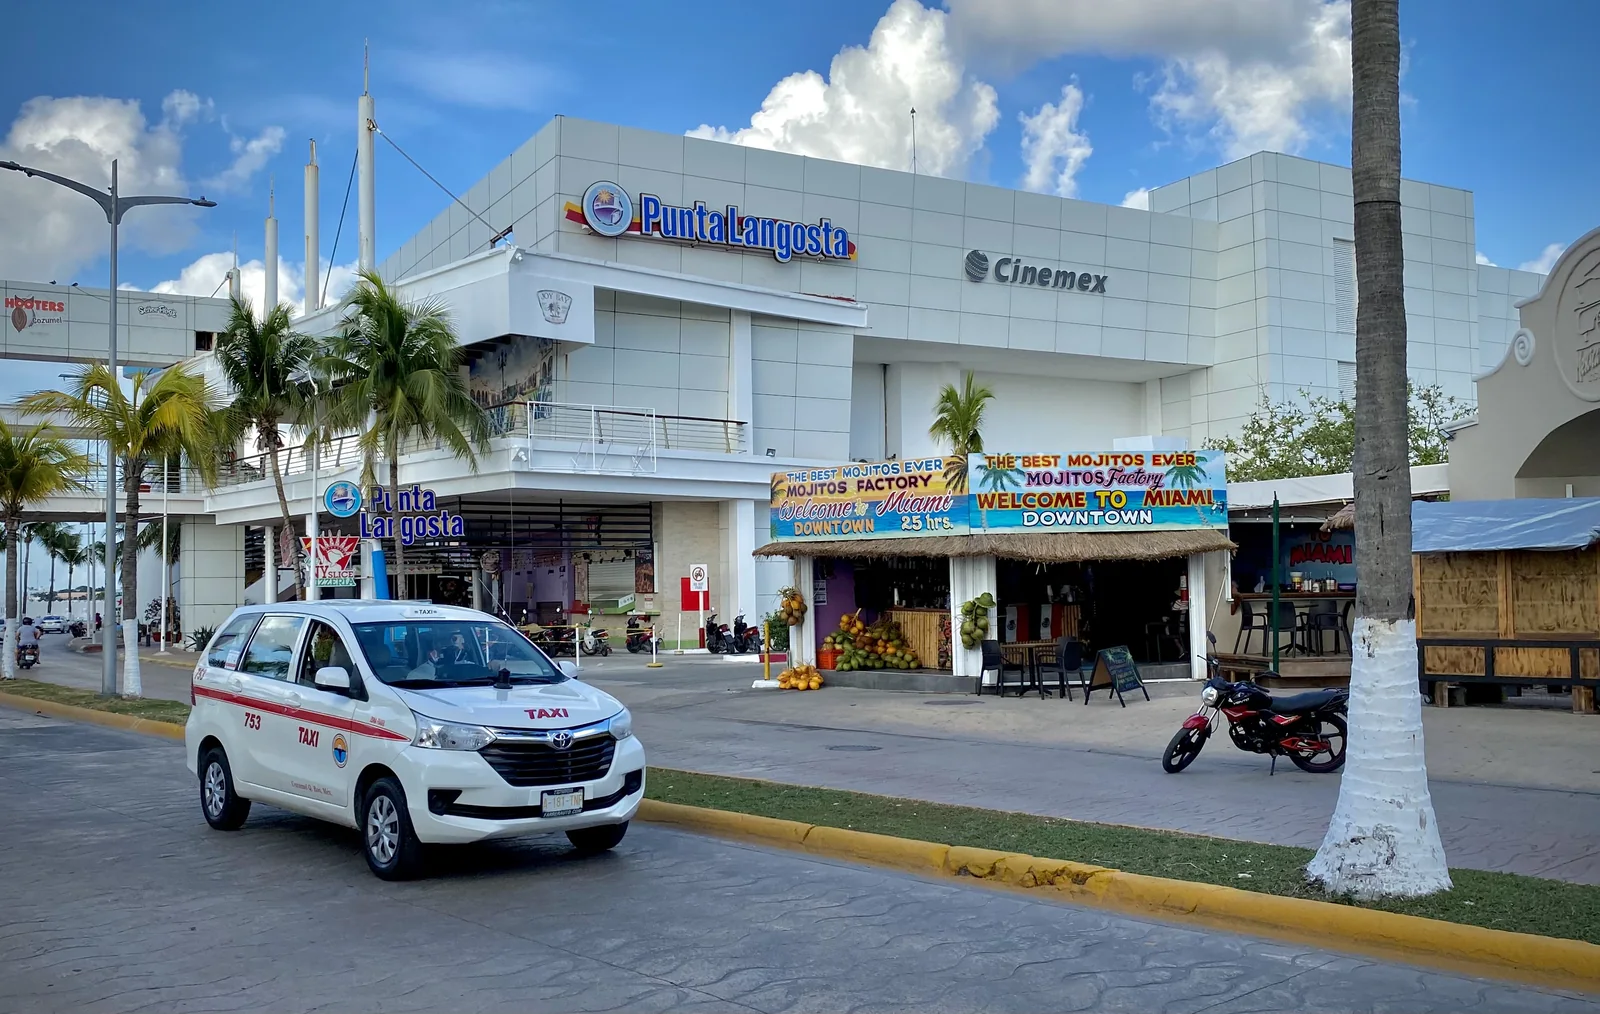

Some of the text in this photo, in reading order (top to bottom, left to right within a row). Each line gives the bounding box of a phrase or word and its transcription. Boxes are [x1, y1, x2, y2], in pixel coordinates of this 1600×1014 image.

[994, 257, 1108, 294] Cinemex
[5, 297, 65, 312] HOOTERS
[32, 316, 62, 324] Cozumel
[786, 458, 943, 483] THE BEST MOJITOS EVER
[985, 453, 1196, 469] THE BEST MOJITOS EVER
[786, 474, 933, 498] MOJITOS FACTORY
[1025, 466, 1165, 491] MOJITOS Factory
[369, 484, 437, 513] Punta
[779, 490, 954, 520] Welcome to Miami
[976, 489, 1214, 510] WELCOME TO MIAMI
[794, 518, 875, 536] DOWNTOWN
[901, 514, 954, 531] 25 hrs.
[1022, 510, 1153, 526] DOWNTOWN
[1290, 543, 1353, 567] MIAMI
[315, 578, 355, 587] IZZERIA
[244, 712, 261, 731] 753
[523, 708, 569, 720] TAXI
[298, 726, 320, 748] TAXI
